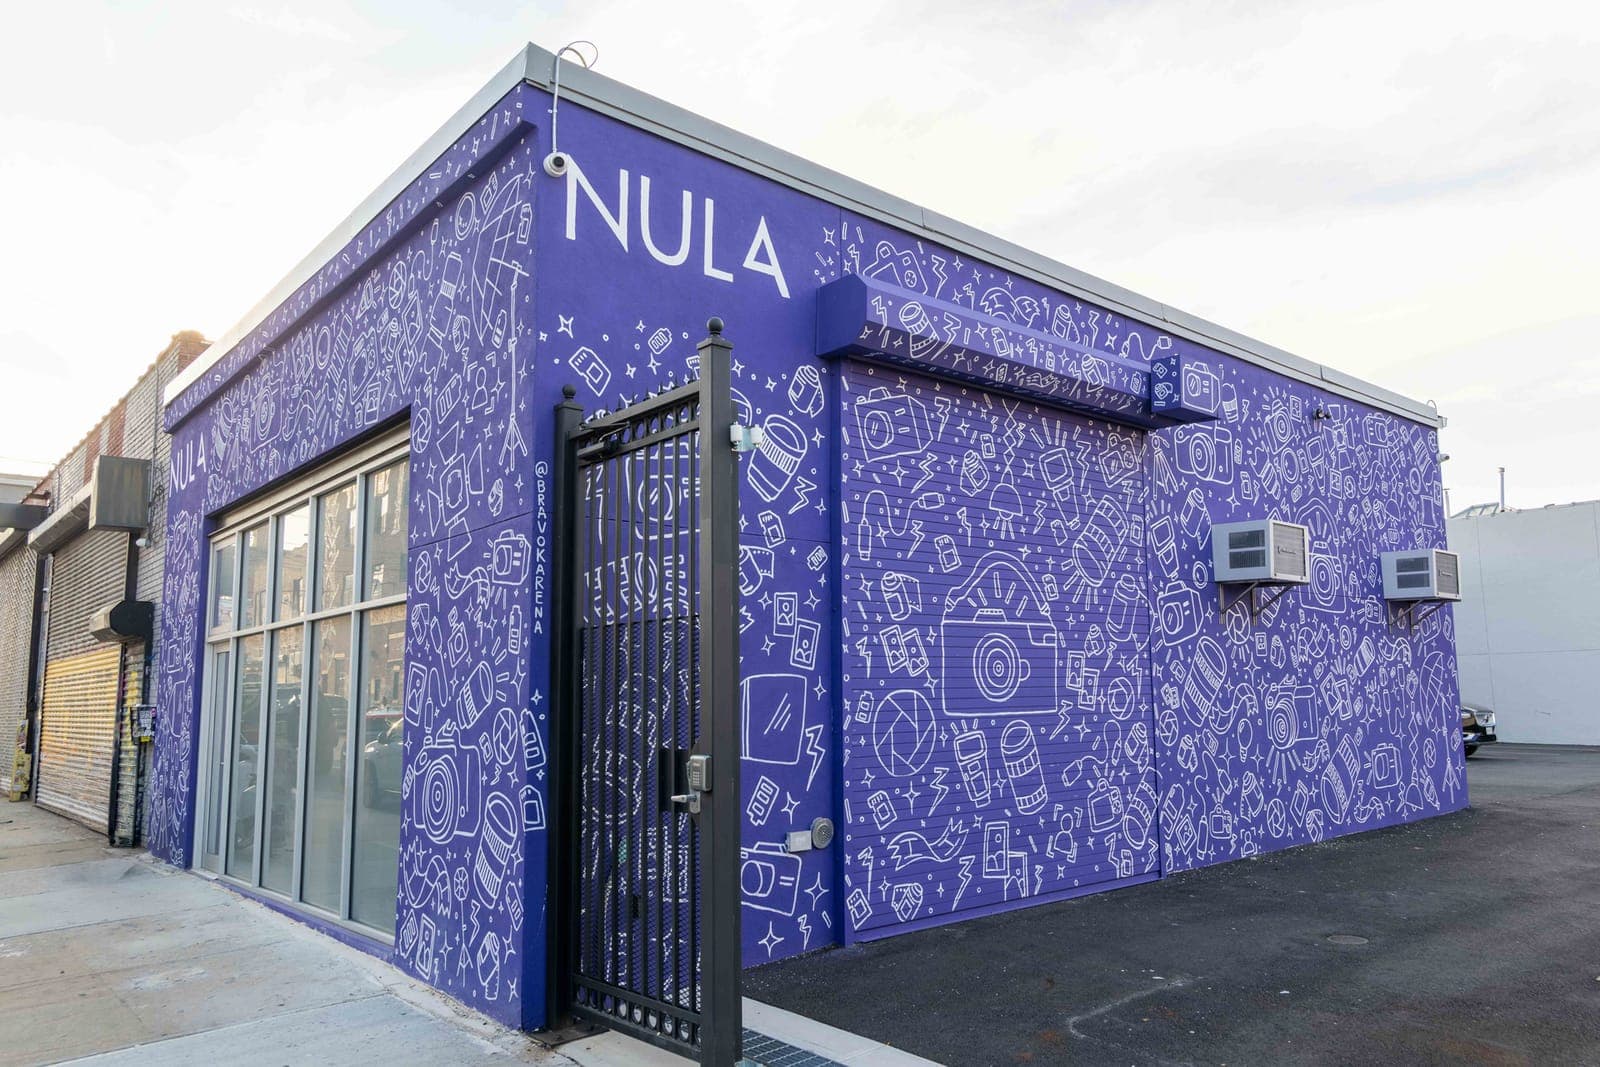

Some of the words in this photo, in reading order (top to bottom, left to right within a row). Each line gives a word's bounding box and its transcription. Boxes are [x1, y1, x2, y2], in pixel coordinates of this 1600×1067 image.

[566, 154, 790, 299] NULA
[169, 431, 206, 498] NULA
[534, 461, 548, 634] @BRAVOKARENA
